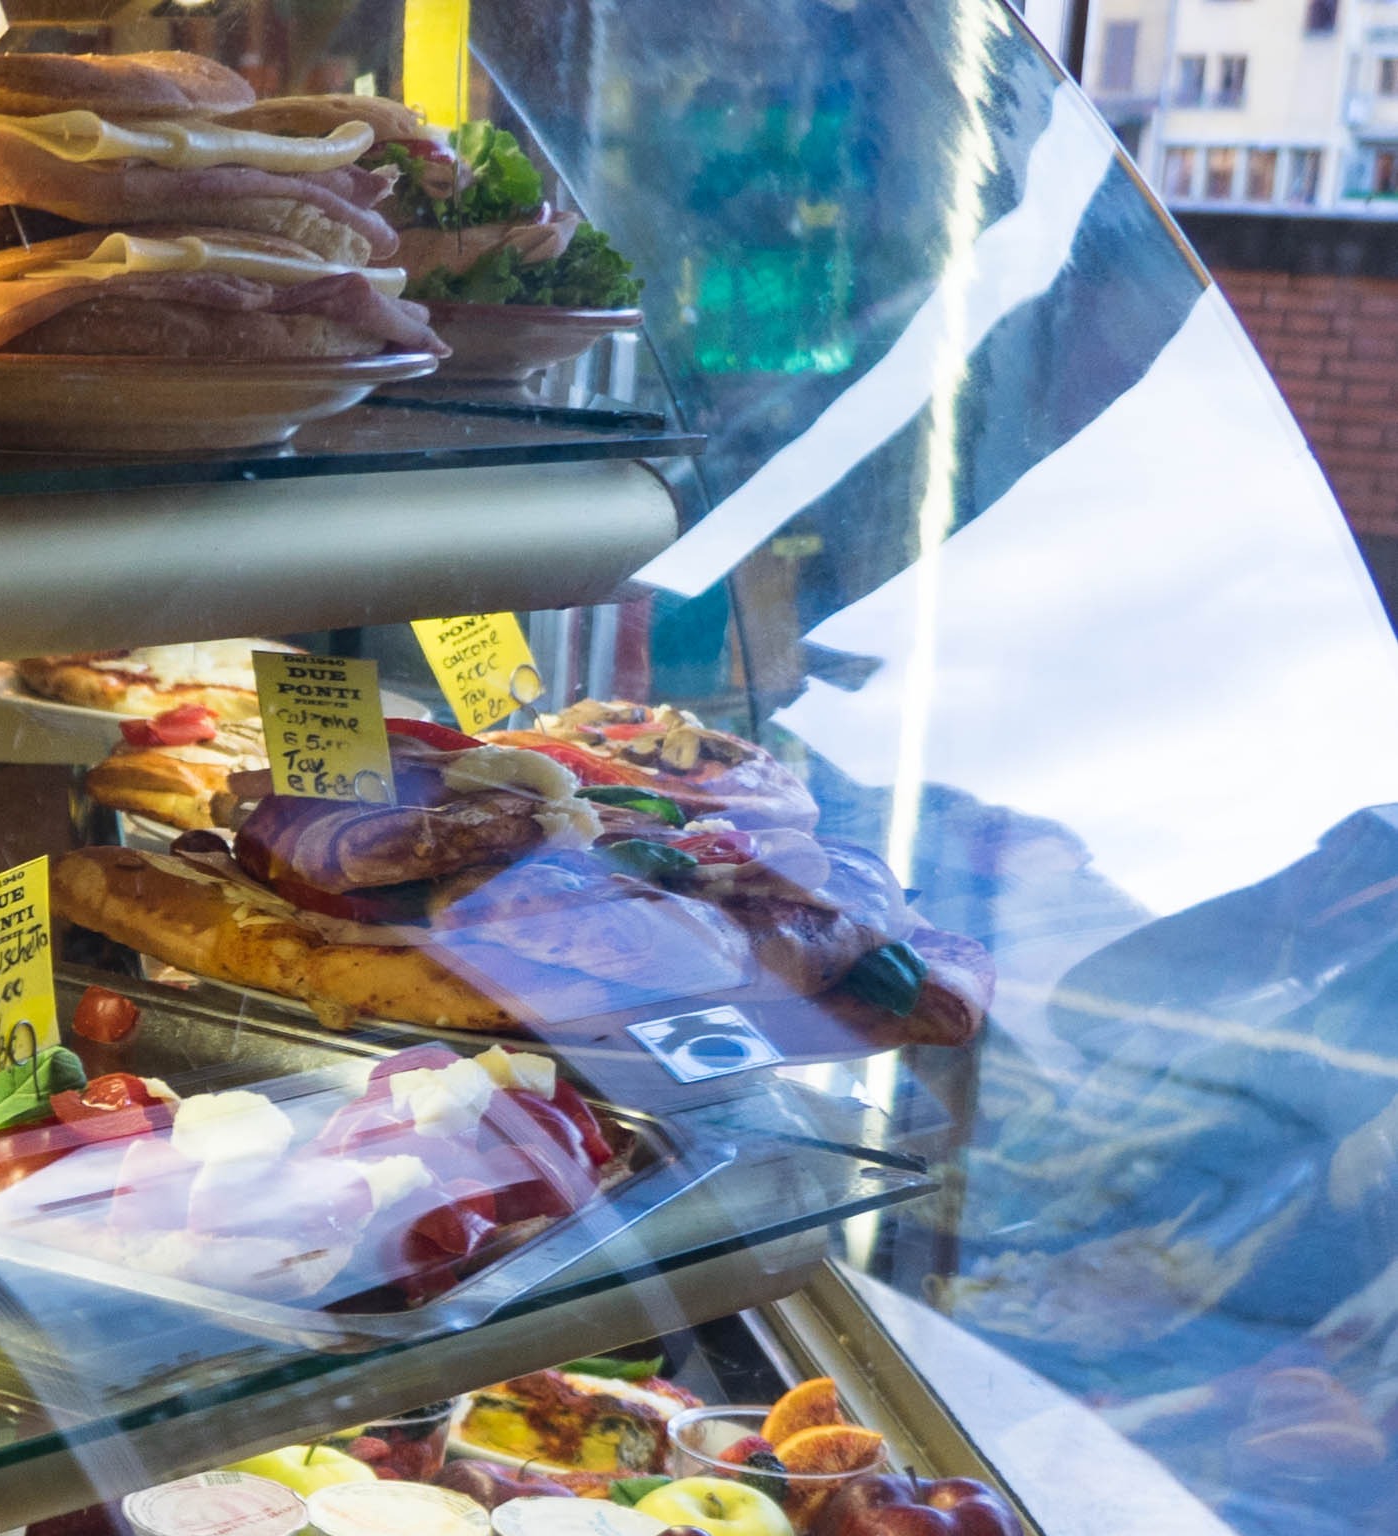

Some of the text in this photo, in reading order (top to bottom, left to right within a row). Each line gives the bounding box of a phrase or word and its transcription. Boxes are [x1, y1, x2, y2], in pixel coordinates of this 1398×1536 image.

[287, 667, 346, 681] DUE
[277, 682, 361, 700] PONTI
[282, 749, 325, 773] Tav
